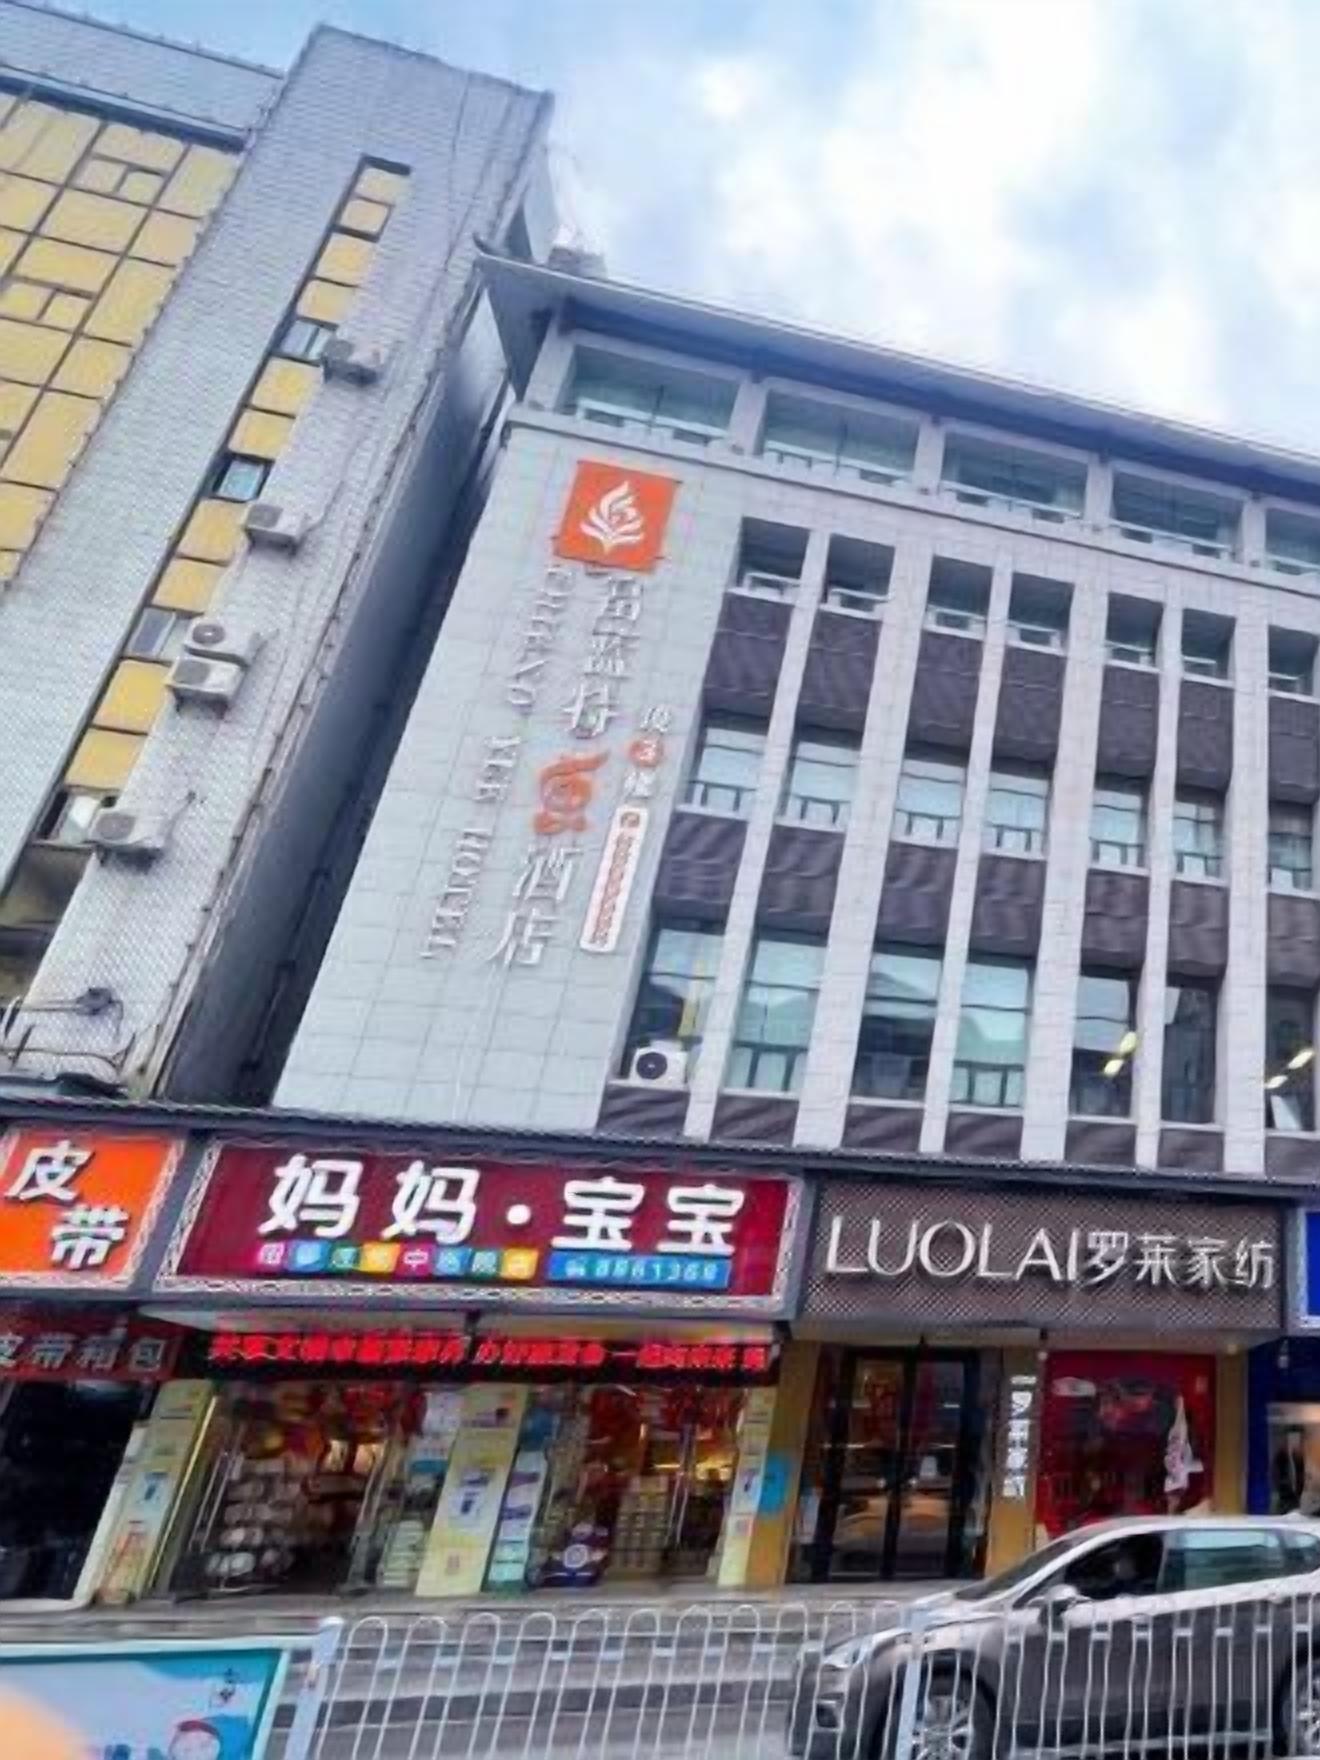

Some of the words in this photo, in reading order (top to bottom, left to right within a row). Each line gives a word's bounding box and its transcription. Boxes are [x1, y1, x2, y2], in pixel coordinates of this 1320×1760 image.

[4, 1140, 130, 1271] 皮带
[826, 1216, 1079, 1282] LUOLAI
[1082, 1229, 1275, 1289] 罗莱家纺
